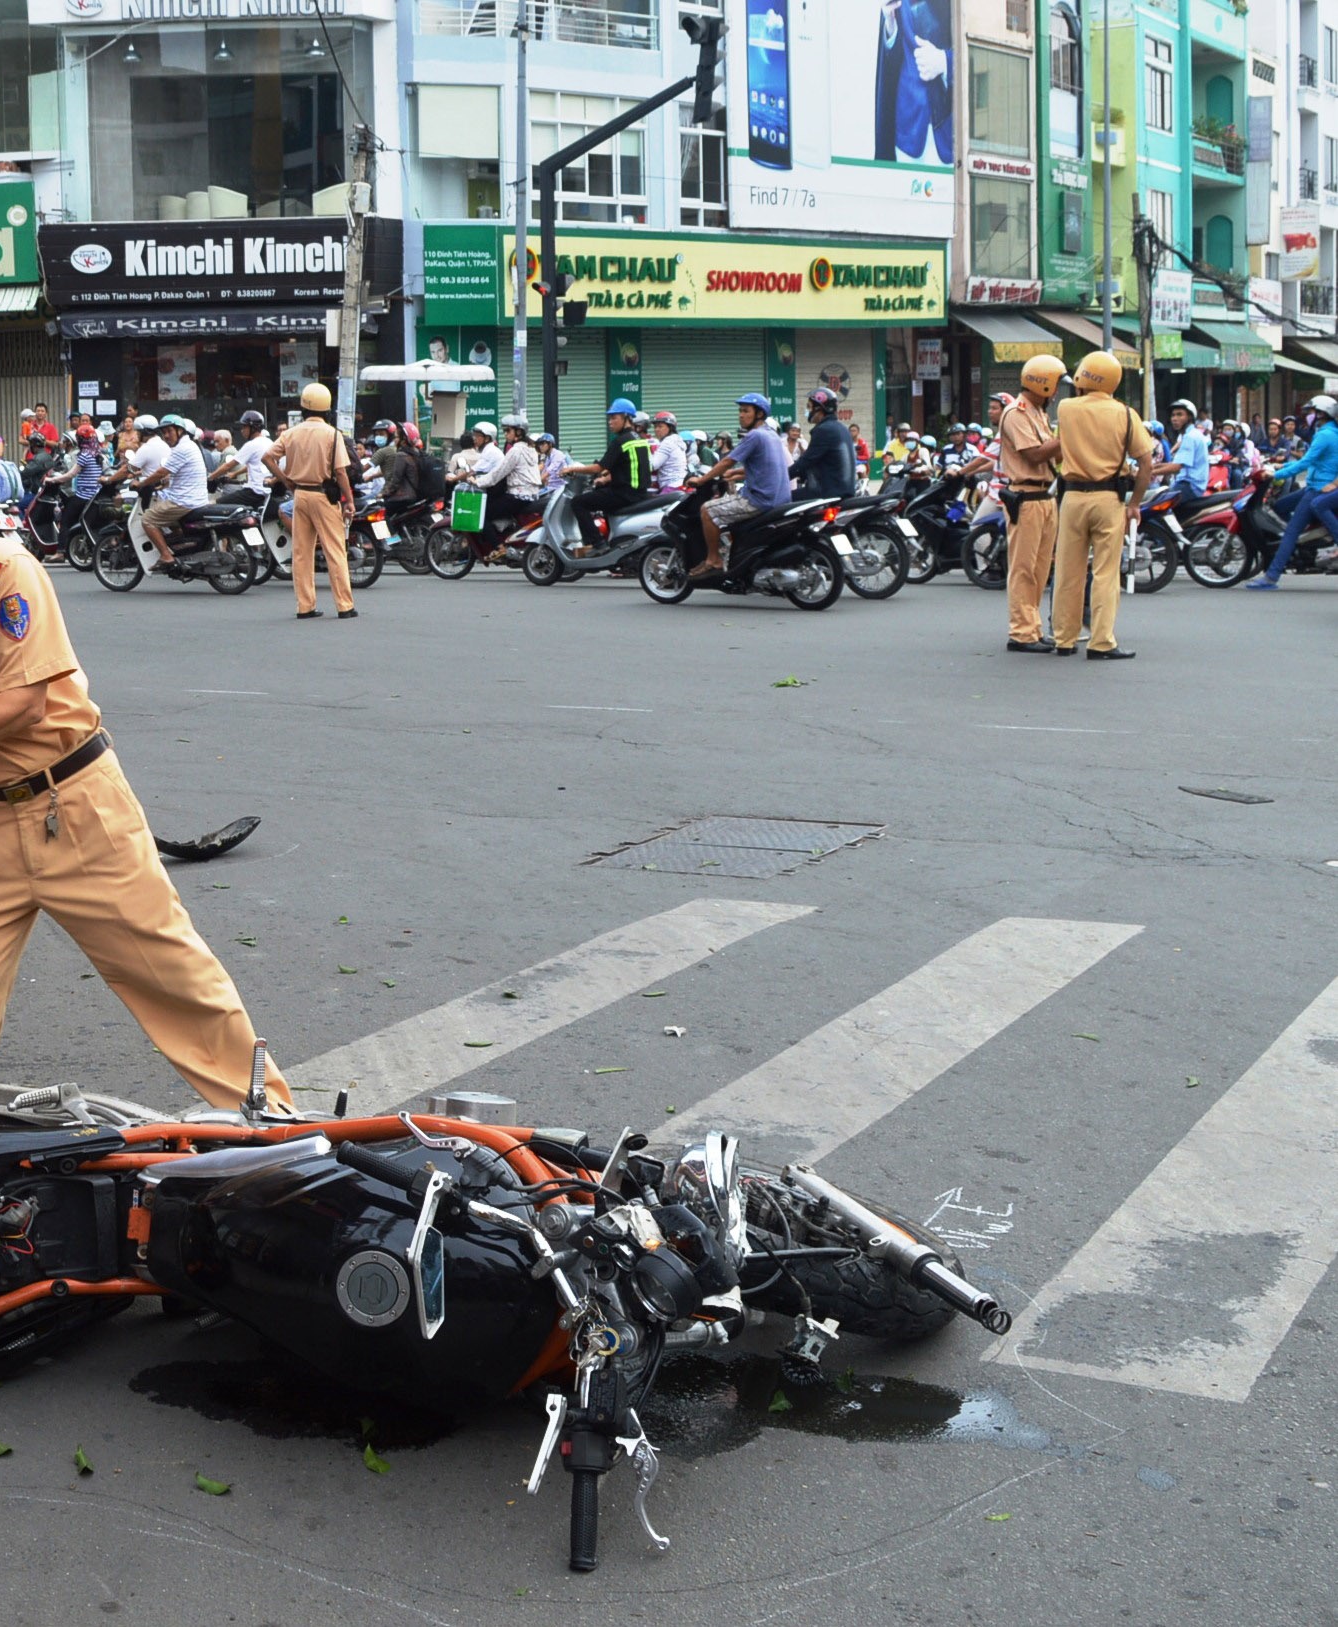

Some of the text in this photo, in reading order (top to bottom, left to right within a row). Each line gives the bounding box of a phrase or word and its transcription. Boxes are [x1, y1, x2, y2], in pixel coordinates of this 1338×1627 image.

[750, 186, 778, 205] Find
[781, 187, 790, 206] 7
[802, 189, 816, 208] 7a
[125, 238, 233, 277] Kimchi
[424, 250, 436, 258] 110
[457, 276, 470, 284] 820
[706, 270, 803, 294] SHOWROOM
[294, 288, 320, 297] Korean
[117, 317, 228, 329] Kimchi
[478, 385, 496, 393] Arabica
